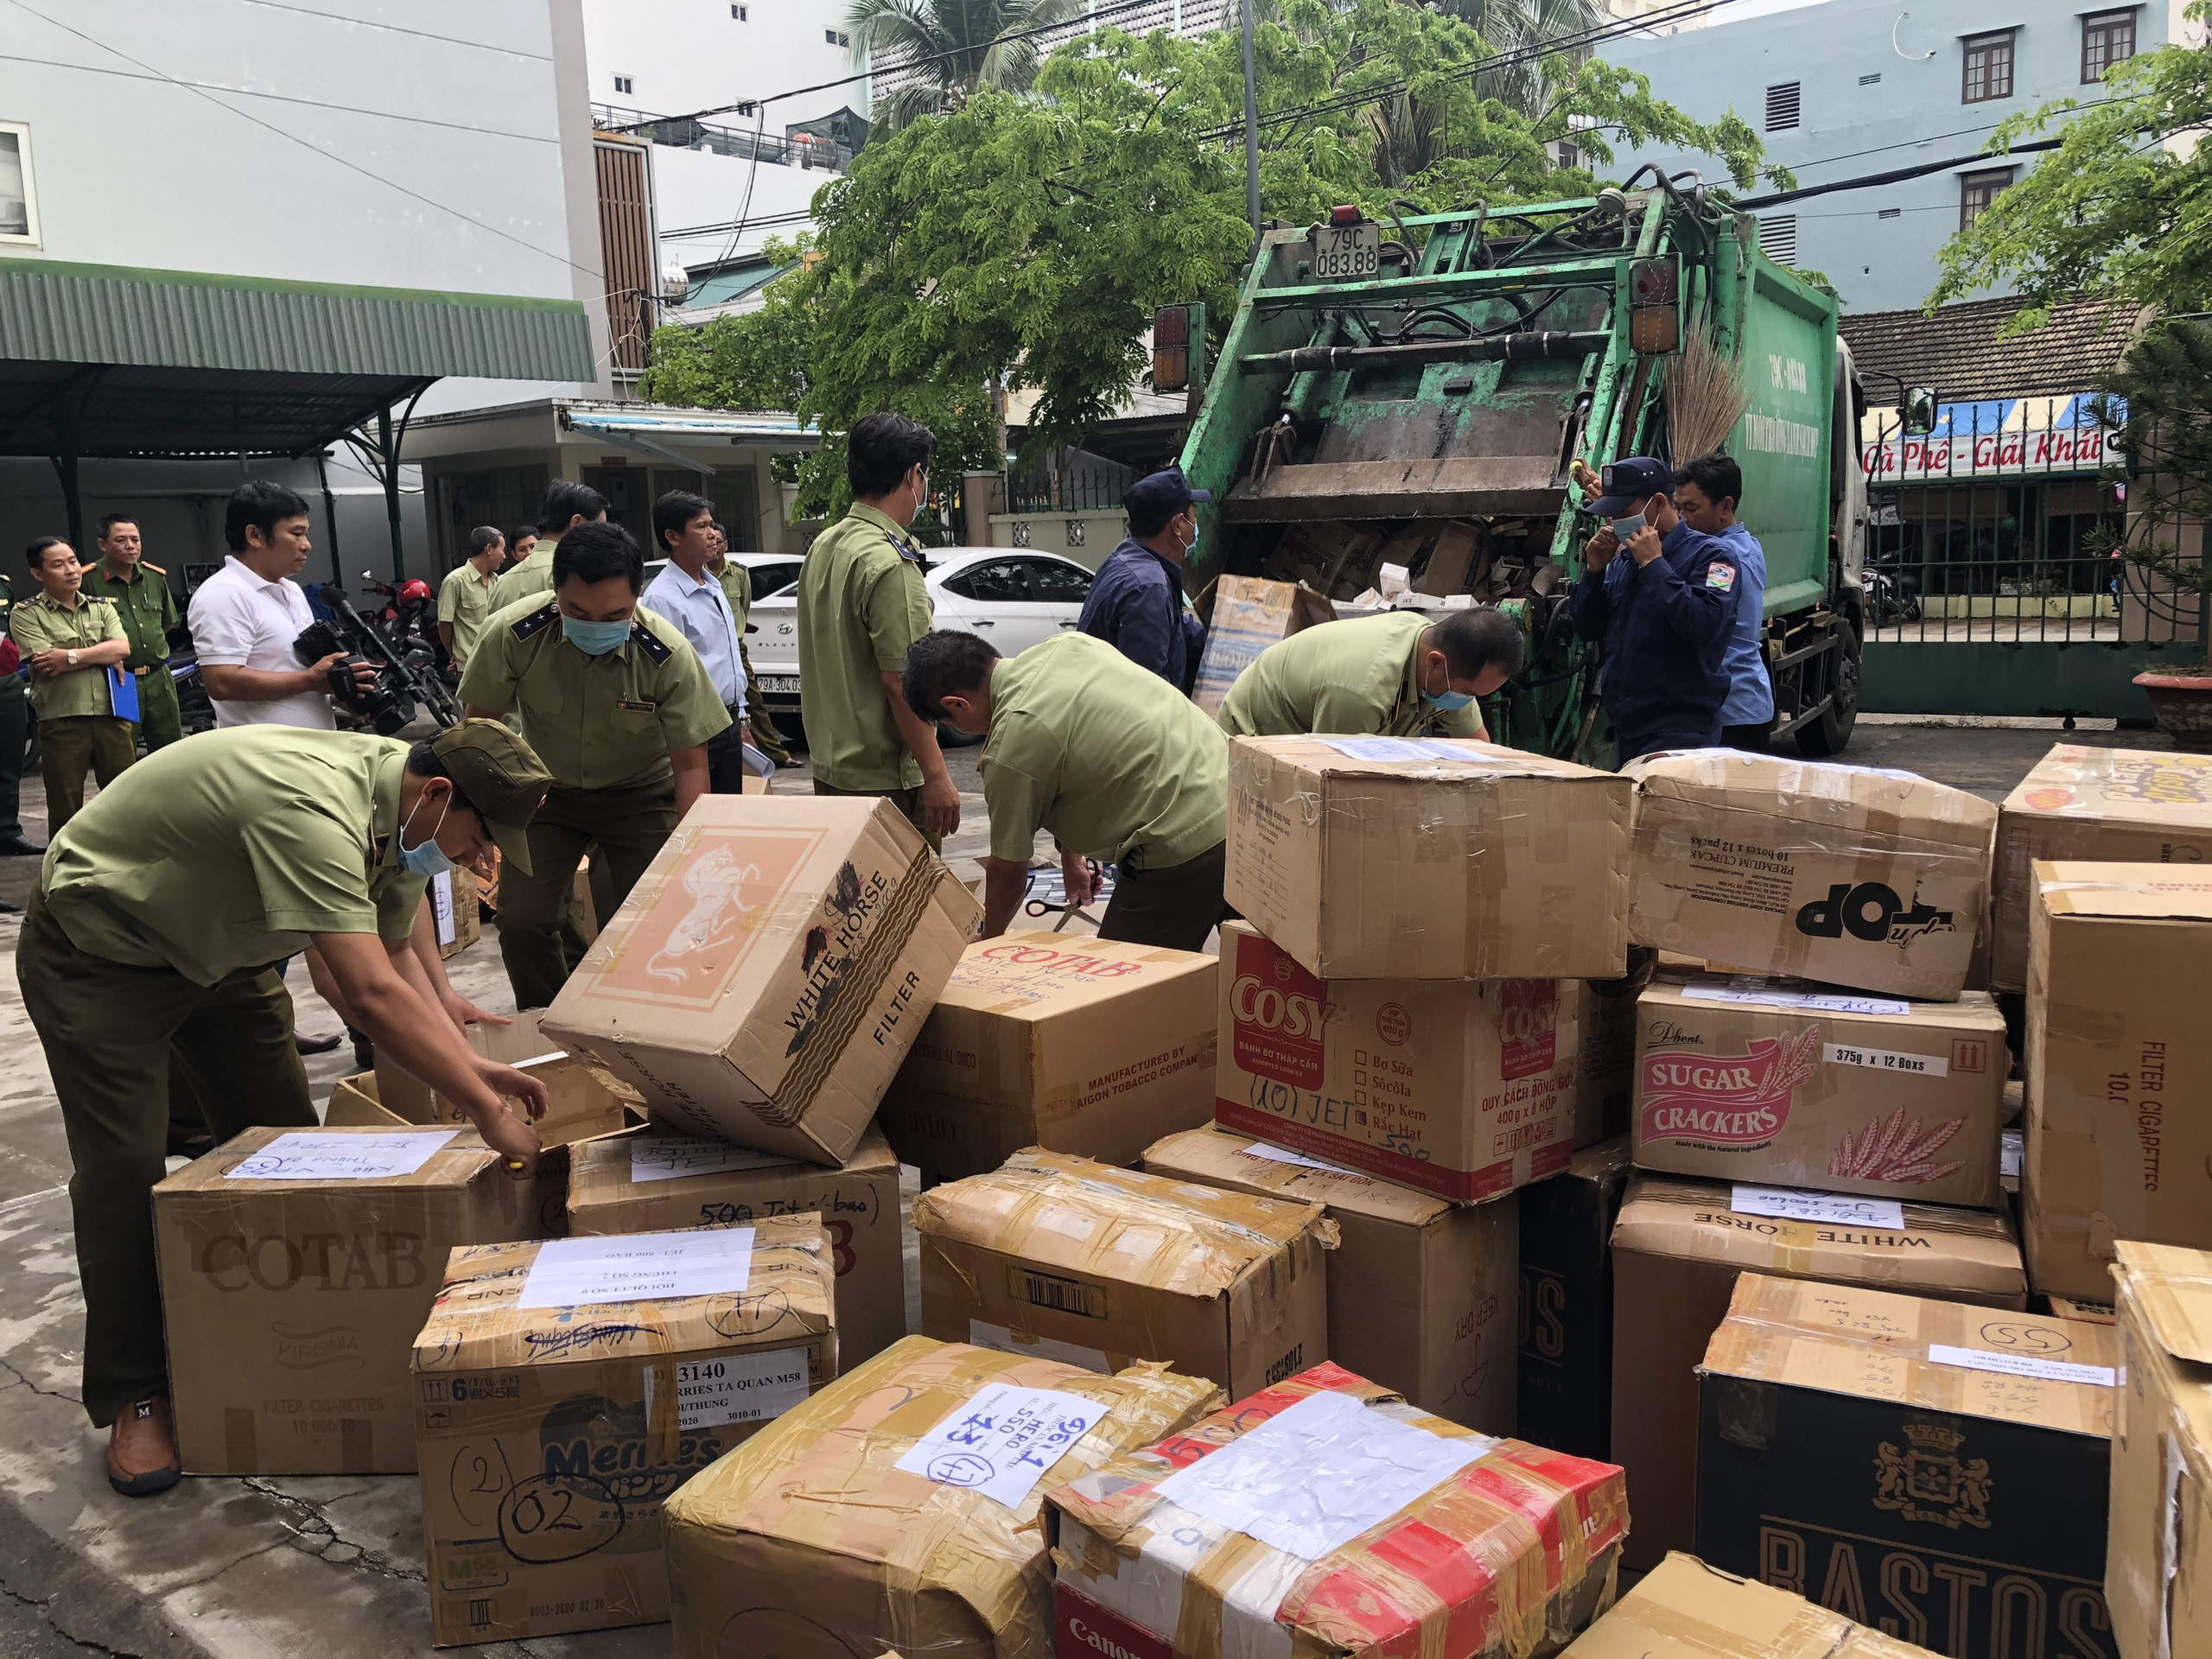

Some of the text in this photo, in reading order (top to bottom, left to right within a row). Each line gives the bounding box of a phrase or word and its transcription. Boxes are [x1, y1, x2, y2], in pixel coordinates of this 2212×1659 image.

[1331, 228, 1363, 252] 79C
[1318, 250, 1376, 276] 083.88
[1863, 443, 1894, 474] Cà
[1903, 440, 1949, 471] Phê
[2034, 429, 2101, 464] Khát
[1690, 836, 1720, 849] packs
[1723, 842, 1733, 853] 12
[1745, 846, 1775, 860] boxes
[1738, 858, 1795, 875] PREMIUM
[1777, 852, 1789, 861] 10
[785, 871, 887, 1031] WHITE HORSE
[982, 945, 1142, 977] COTAB
[873, 970, 921, 1046] FILTER
[1230, 973, 1337, 1045] COSY
[1382, 1024, 1397, 1035] 400
[1498, 999, 1560, 1045] COSY
[1088, 1046, 1185, 1091] MANUFACTURED BY
[1251, 1058, 1303, 1077] ASSORTED COOKIES
[1374, 1055, 1413, 1077] Bơ Sữa
[1836, 1048, 1924, 1071] 375g x 12 Boxs
[2140, 1041, 2165, 1092] FILTER
[1076, 1055, 1198, 1109] AIGON TOBACCO COMPAN
[1373, 1076, 1412, 1097] Sôcôla
[1652, 1064, 1758, 1090] SUGAR
[1373, 1096, 1427, 1122] Kẹp Kem
[1482, 1094, 1501, 1112] QUY
[1503, 1086, 1529, 1106] CÁCH
[1306, 1095, 1356, 1130] JET
[1497, 1109, 1514, 1125] 400
[1531, 1103, 1536, 1116] 8
[1654, 1105, 1777, 1135] CRACKERS
[1675, 1140, 1771, 1154] Made with the Natural Ingredients
[1694, 1213, 1932, 1249] WHITE HORSE
[201, 1232, 428, 1293] COTAB
[1454, 1291, 1499, 1344] KEEP DRY
[278, 1336, 359, 1359] VIRGINIA
[451, 1378, 467, 1401] 6
[717, 1382, 734, 1392] TA
[737, 1376, 773, 1391] QUAN
[777, 1372, 801, 1385] M58
[138, 1407, 150, 1418] M
[264, 1398, 385, 1414] FILTER CIGARETTES
[727, 1409, 761, 1421] 3010-01
[999, 1408, 1034, 1434] 550
[1008, 1418, 1046, 1449] HERO
